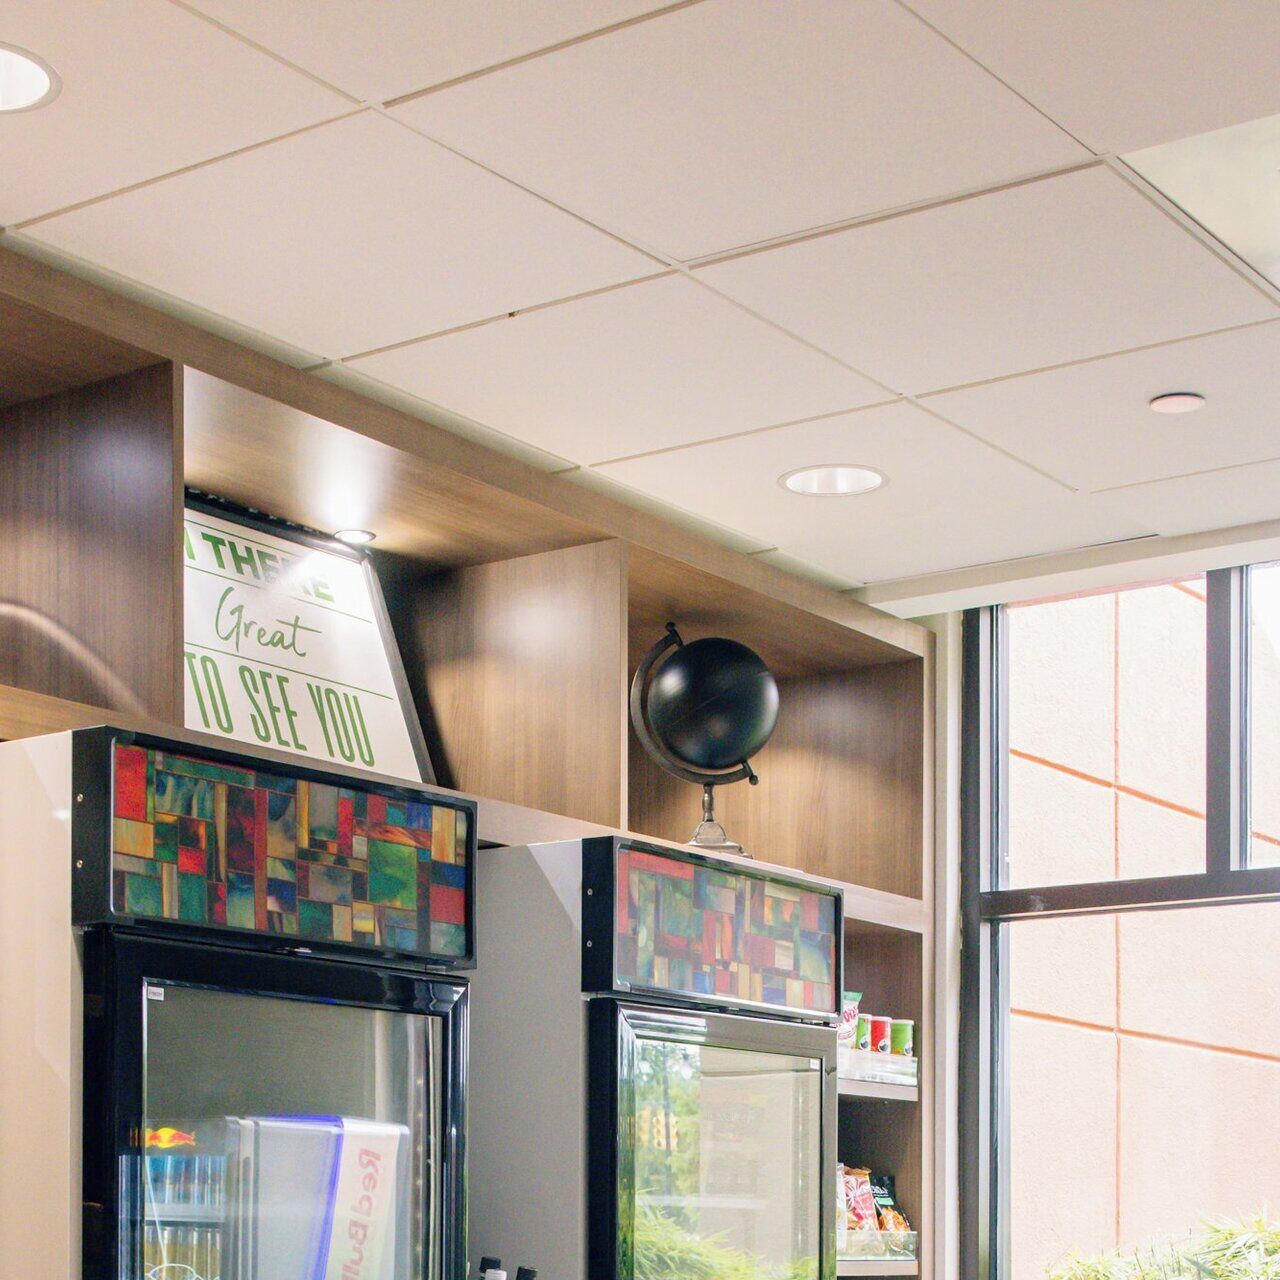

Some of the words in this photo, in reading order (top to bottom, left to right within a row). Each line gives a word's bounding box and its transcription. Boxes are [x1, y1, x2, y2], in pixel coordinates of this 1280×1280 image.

[201, 532, 335, 603] THEE
[215, 587, 322, 657] Great
[184, 652, 234, 734] TO
[238, 665, 308, 752] SEE
[306, 682, 376, 768] YOU
